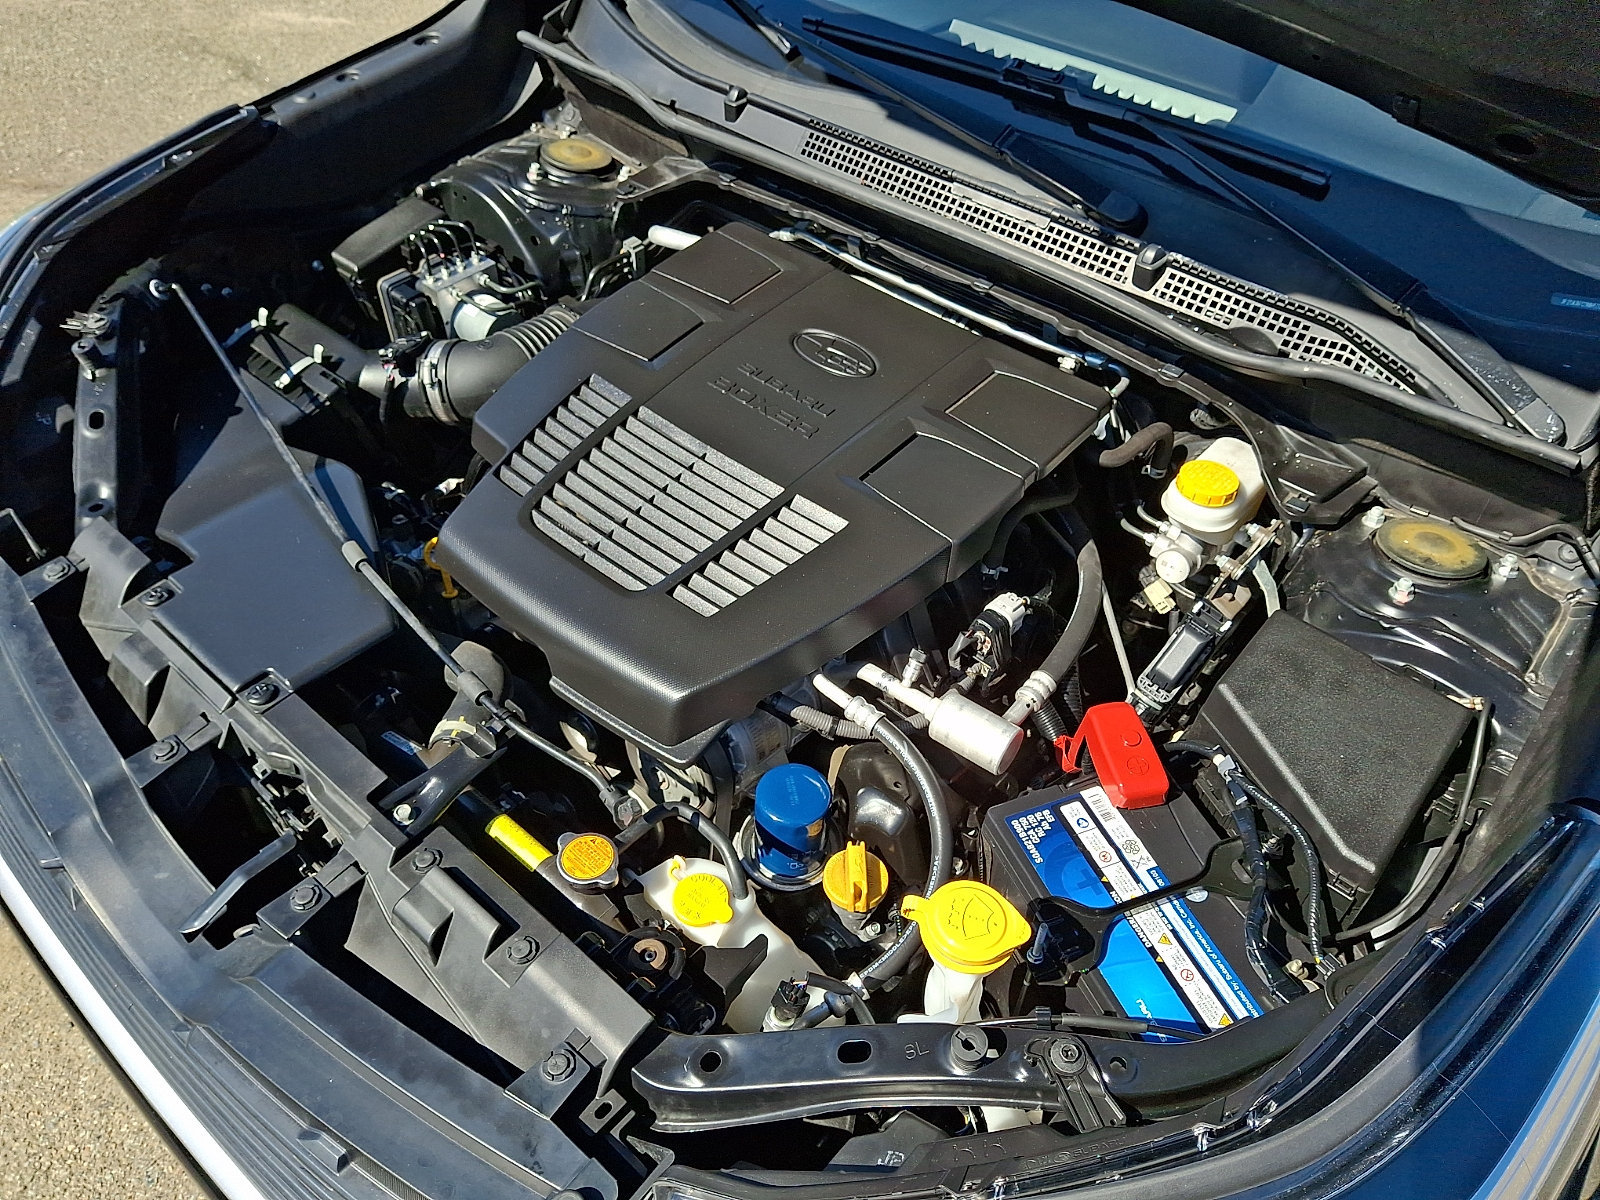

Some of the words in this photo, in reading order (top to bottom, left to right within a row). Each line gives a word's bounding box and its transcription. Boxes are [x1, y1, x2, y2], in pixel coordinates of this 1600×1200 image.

[737, 362, 836, 418] SUBARU
[707, 376, 820, 440] BOXER
[1018, 815, 1032, 831] 750
[1026, 813, 1039, 828] 120
[1027, 828, 1041, 844] CCA
[1034, 825, 1046, 838] RC
[1213, 959, 1234, 982] Subaru
[1235, 989, 1260, 1019] istributed
[904, 1041, 930, 1060] SL
